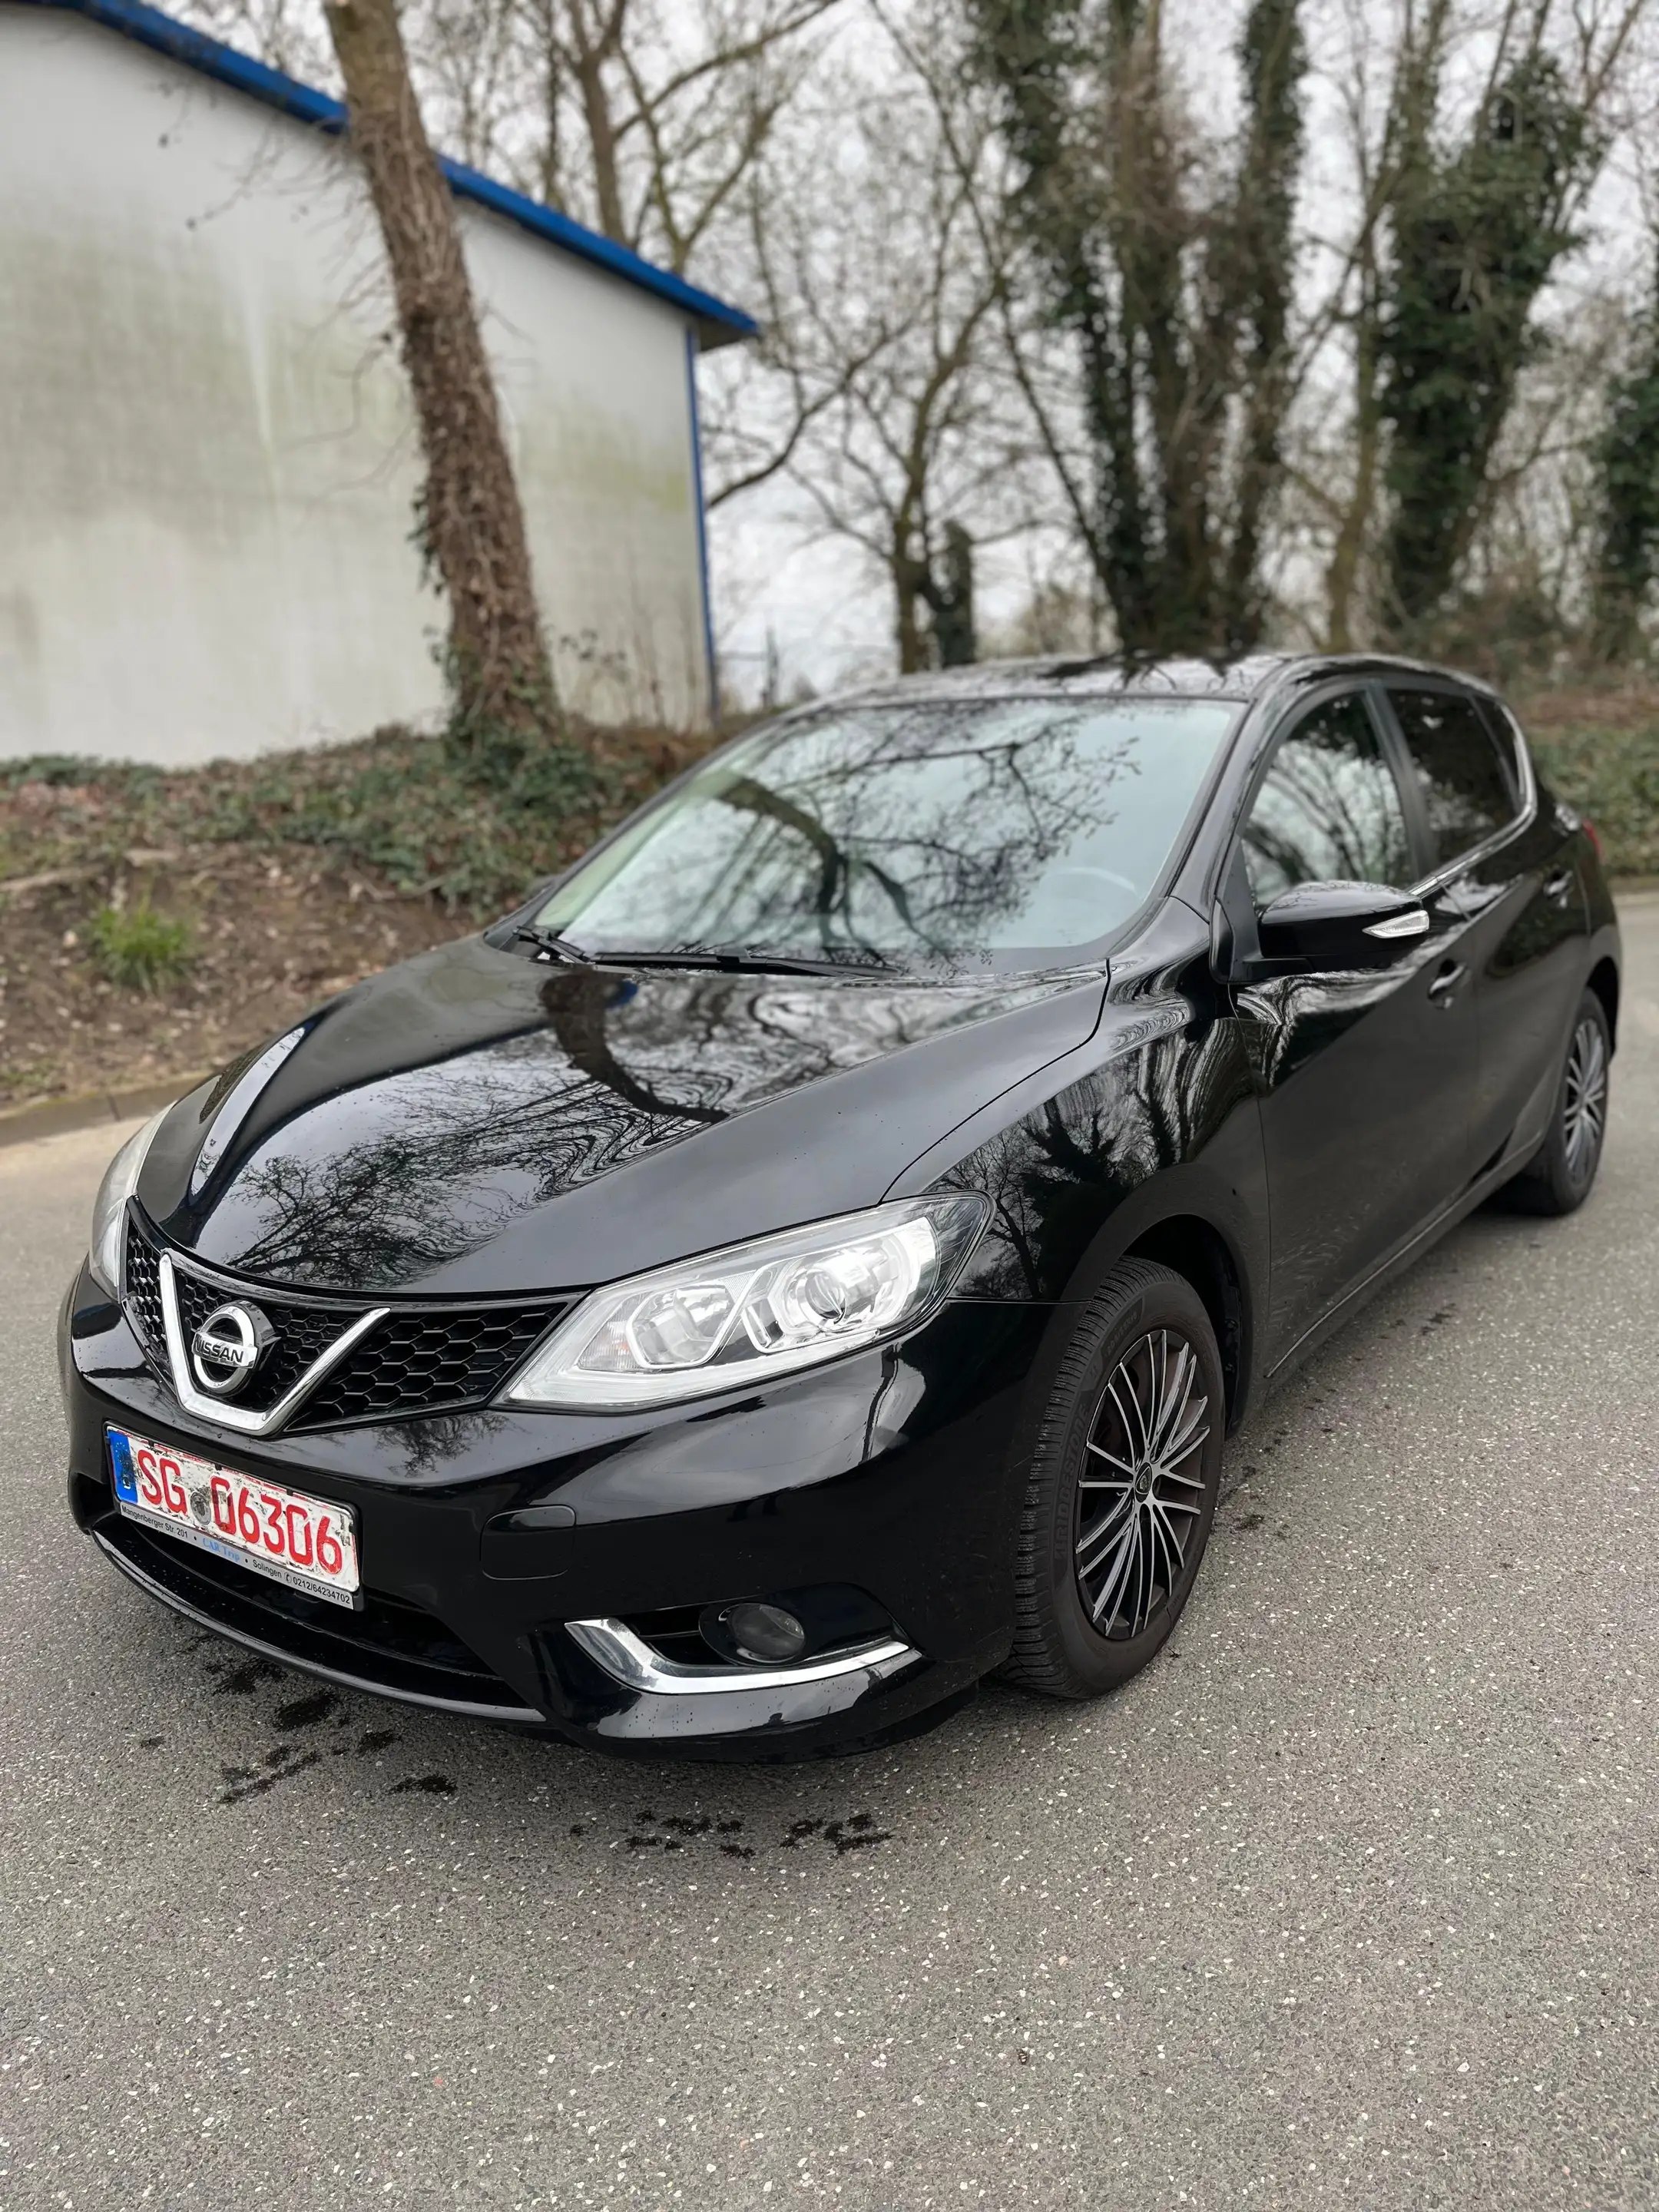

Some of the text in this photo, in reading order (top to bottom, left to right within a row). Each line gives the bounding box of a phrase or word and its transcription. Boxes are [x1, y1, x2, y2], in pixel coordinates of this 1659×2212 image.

[194, 1336, 244, 1363] NISSAN
[121, 1505, 164, 1528] Mangenberger
[165, 1522, 175, 1534] Str.
[177, 1527, 188, 1538] 201
[202, 1538, 220, 1553] CAR
[252, 1559, 283, 1578] Solingen
[293, 1577, 351, 1604] 0212/64234702
[137, 1449, 343, 1575] SG 06306
